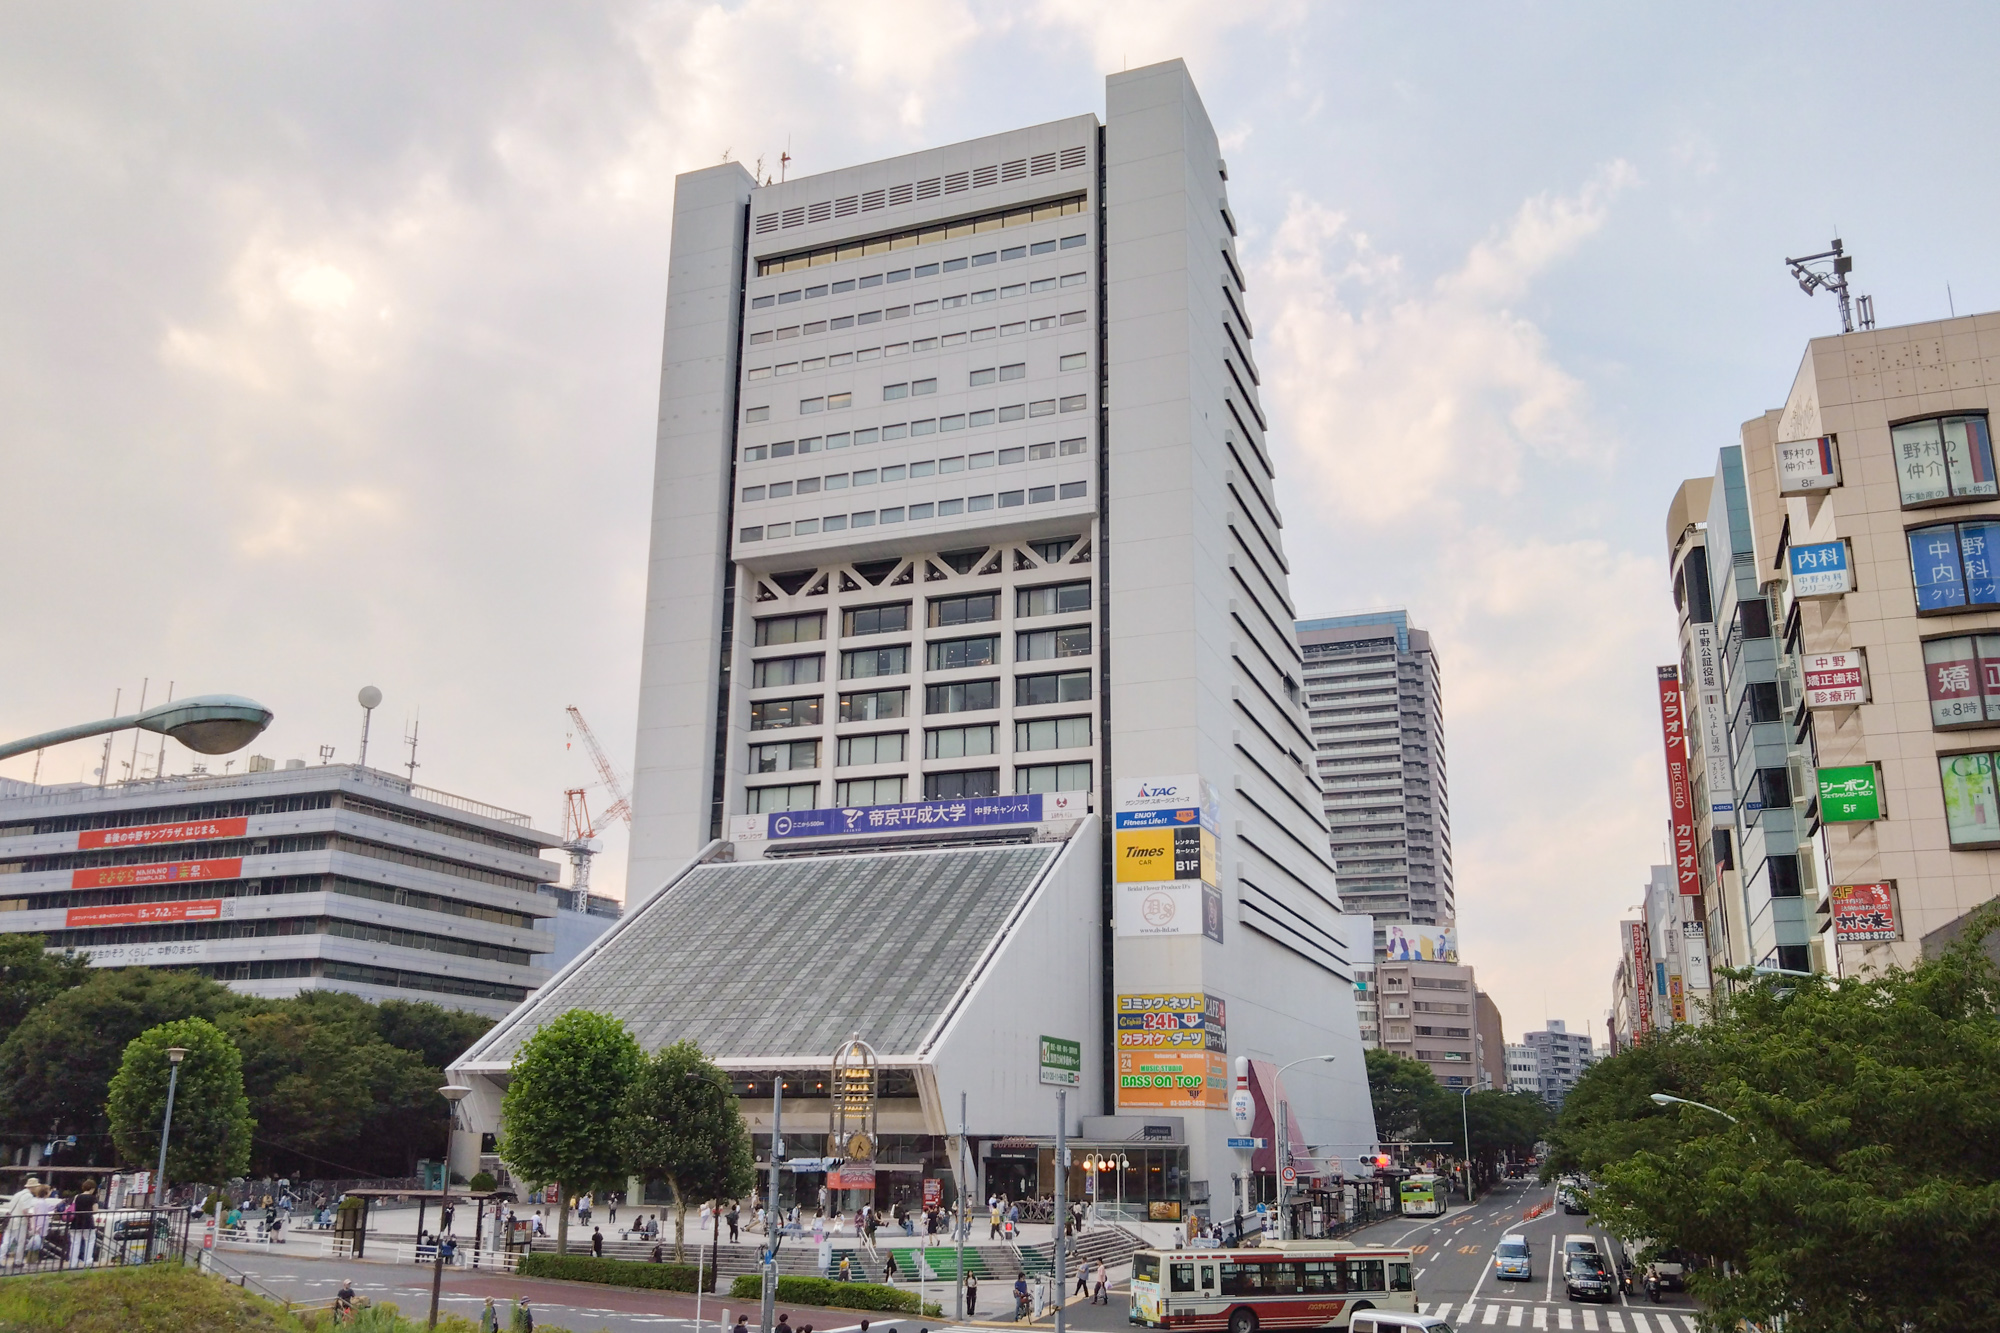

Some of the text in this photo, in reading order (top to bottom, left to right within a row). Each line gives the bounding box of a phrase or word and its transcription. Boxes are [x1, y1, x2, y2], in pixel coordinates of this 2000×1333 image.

[1782, 448, 1814, 460] 野村の
[1903, 440, 1956, 459] 野村の
[1801, 479, 1815, 487] 8F
[1928, 536, 1985, 559] 中野
[1797, 547, 1839, 569] 内科
[1932, 559, 1989, 583] 内科
[1798, 573, 1842, 585] 中野内科
[1801, 582, 1843, 593] クリニック
[1699, 628, 1715, 687] 中野公証役場
[1815, 656, 1846, 668] 中野
[1806, 671, 1860, 687] 矯正歯科
[1814, 689, 1857, 703] 診療所
[1663, 691, 1683, 748] カラオケ
[1708, 707, 1720, 753] いちよし証券
[1151, 786, 1177, 797] TAC
[1670, 762, 1685, 809] BIG ECHO
[868, 803, 966, 828] 帝京平成大学
[974, 804, 1029, 816] 中野キャンパス
[1134, 811, 1157, 819] ENJOY
[1843, 804, 1857, 813] 5F
[104, 825, 220, 843] 最後の中野サンプラザ、はじまる。
[1126, 846, 1165, 858] Times
[1676, 824, 1696, 883] カラオケ
[136, 867, 168, 876] NAKANO
[1175, 860, 1199, 871] B1F
[1832, 886, 1853, 898] 4F
[1836, 910, 1893, 930] 村さ来
[1632, 926, 1641, 953] カラオケ
[1848, 931, 1895, 940] 3388-8720
[129, 947, 153, 957] くらしに
[158, 945, 200, 956] 中野のまちに
[1121, 996, 1201, 1010] コミック・ネット
[1638, 989, 1646, 1016] カラオケ
[1143, 1012, 1179, 1030] 24h
[1186, 1015, 1196, 1023] B1
[1121, 1032, 1202, 1046] カラオケ・ダーツ
[1121, 1058, 1132, 1068] 24
[1140, 1064, 1183, 1073] MUSIC STUDIO
[1121, 1075, 1202, 1088] BASS ON TOP
